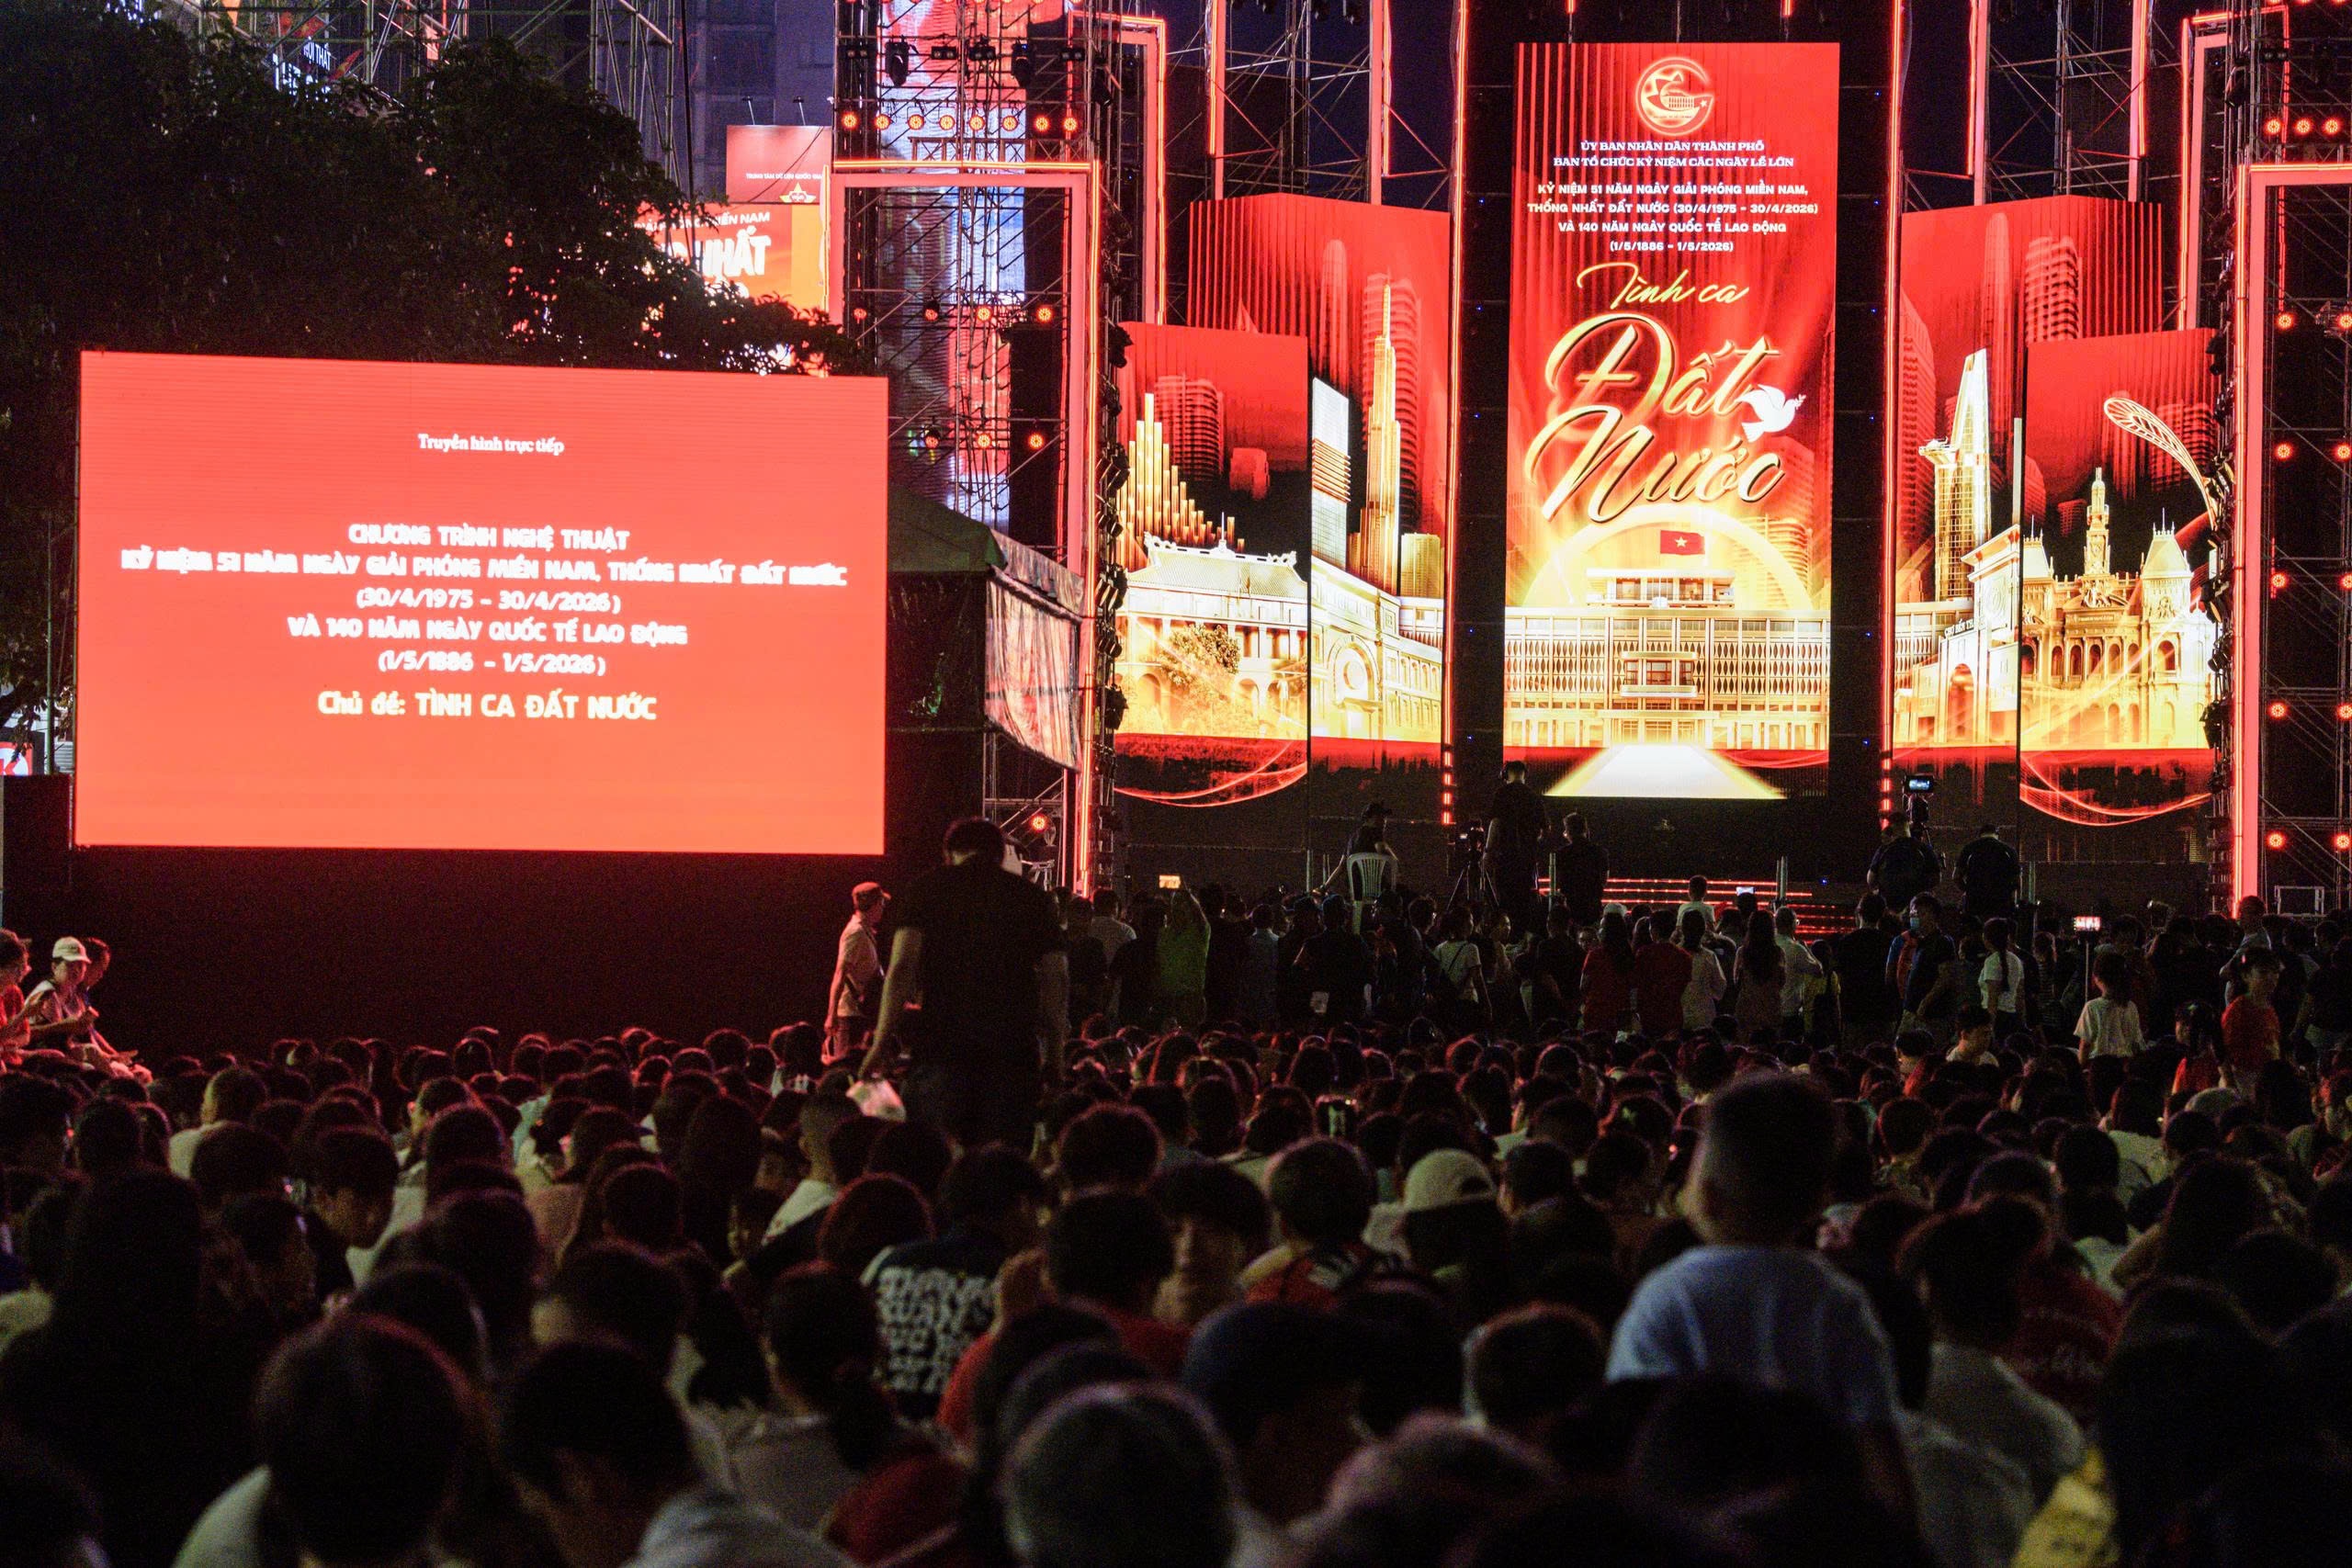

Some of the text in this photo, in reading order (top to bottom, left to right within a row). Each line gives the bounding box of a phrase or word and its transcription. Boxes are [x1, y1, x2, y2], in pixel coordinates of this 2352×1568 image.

[1600, 141, 1626, 152] BAN
[1627, 140, 1663, 152] NHÂN
[1664, 140, 1690, 152] DÂN
[1692, 140, 1736, 152] THÀNH
[1737, 139, 1765, 152] PHỐ
[1554, 157, 1580, 167] BAN
[1600, 155, 1634, 167] CHỨC
[1655, 156, 1687, 168] NIỆM
[1689, 156, 1714, 167] CÁC
[1715, 156, 1748, 167] NGÀY
[1537, 179, 1808, 197] KỶ NIỆM 51 NĂM NGÀY GIẢI PHÓNG MIỀN NAM,
[740, 210, 770, 224] NAM
[1527, 198, 1568, 213] THỐNG
[1572, 198, 1605, 213] NHẤT
[1608, 198, 1633, 213] ĐẤT
[1636, 200, 1670, 213] NƯỚC
[1673, 204, 1737, 214] (30/4/1975
[1749, 204, 1818, 215] 30/4/2026)
[1558, 220, 1575, 231] VÀ
[1578, 222, 1599, 231] 140
[1601, 220, 1629, 231] NĂM
[1632, 220, 1666, 231] NGÀY
[1668, 217, 1702, 233] QUỐC
[1706, 217, 1722, 232] TẾ
[1724, 222, 1749, 232] LAO
[1610, 241, 1664, 252] (1/5/1886
[1677, 242, 1734, 252] 1/5/2026)
[1577, 262, 1750, 310] Tình ca
[1544, 312, 1781, 434] Đất
[417, 433, 469, 453] Truyền
[504, 438, 534, 455] trực
[536, 436, 565, 457] tiếp
[1524, 404, 1785, 524] Nước
[348, 522, 630, 553] CHƯƠNG TRÌNH NGHỆ THUẬT
[302, 550, 361, 575] NGÀY
[366, 551, 406, 577] GIẢI
[413, 553, 481, 579] PHÓNG
[545, 559, 602, 583] NAM,
[606, 556, 675, 583] THỐNG
[356, 586, 473, 610] (30/4/1975
[287, 613, 322, 639] VÀ
[326, 616, 363, 638] 140
[368, 615, 421, 641] NĂM
[426, 615, 483, 642] NGÀY
[488, 615, 548, 643] QUỐC
[553, 616, 579, 643] TẾ
[582, 623, 626, 644] LAO
[378, 649, 474, 672] (1/5/1886
[317, 687, 657, 721] Chủ đề: TÌNH CA ĐẤT NƯỚC
